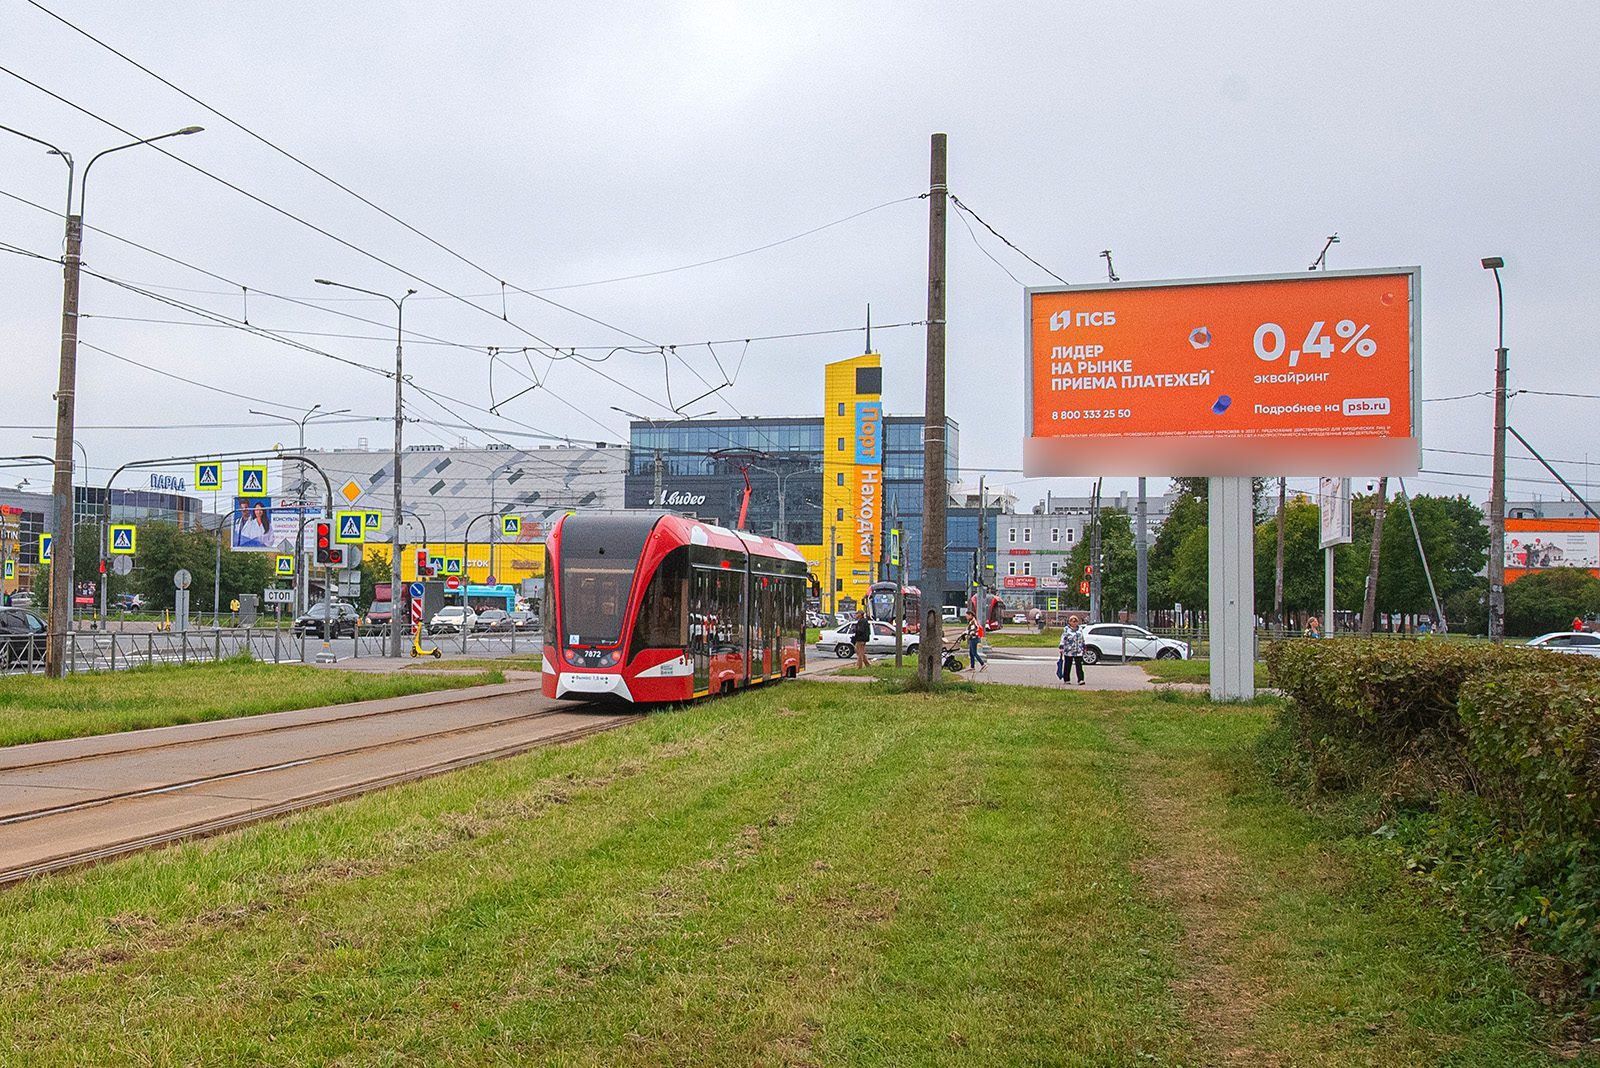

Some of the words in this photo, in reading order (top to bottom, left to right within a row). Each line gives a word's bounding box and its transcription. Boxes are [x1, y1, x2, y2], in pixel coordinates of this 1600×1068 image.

[1075, 311, 1117, 327] ПСБ
[1253, 319, 1377, 367] 0,4%
[1050, 345, 1104, 360] ЛИДЕР
[1051, 362, 1073, 375] НА
[1077, 360, 1133, 374] РЫНКЕ
[1051, 376, 1117, 391] ПРИЕМА
[1253, 371, 1330, 385] эквайринг
[1052, 411, 1059, 420] 8
[1060, 411, 1081, 419] 800
[1083, 410, 1101, 419] 333
[1103, 409, 1116, 418] 25
[1118, 409, 1131, 418] 50
[1254, 403, 1321, 415] Подробнее
[1325, 403, 1340, 412] на
[1348, 401, 1386, 413] psb.ru
[858, 407, 879, 458] Порт
[150, 473, 186, 491] ПАРАД
[857, 469, 878, 557] Находка
[268, 591, 291, 601] СТОП
[584, 650, 602, 659] 7872
